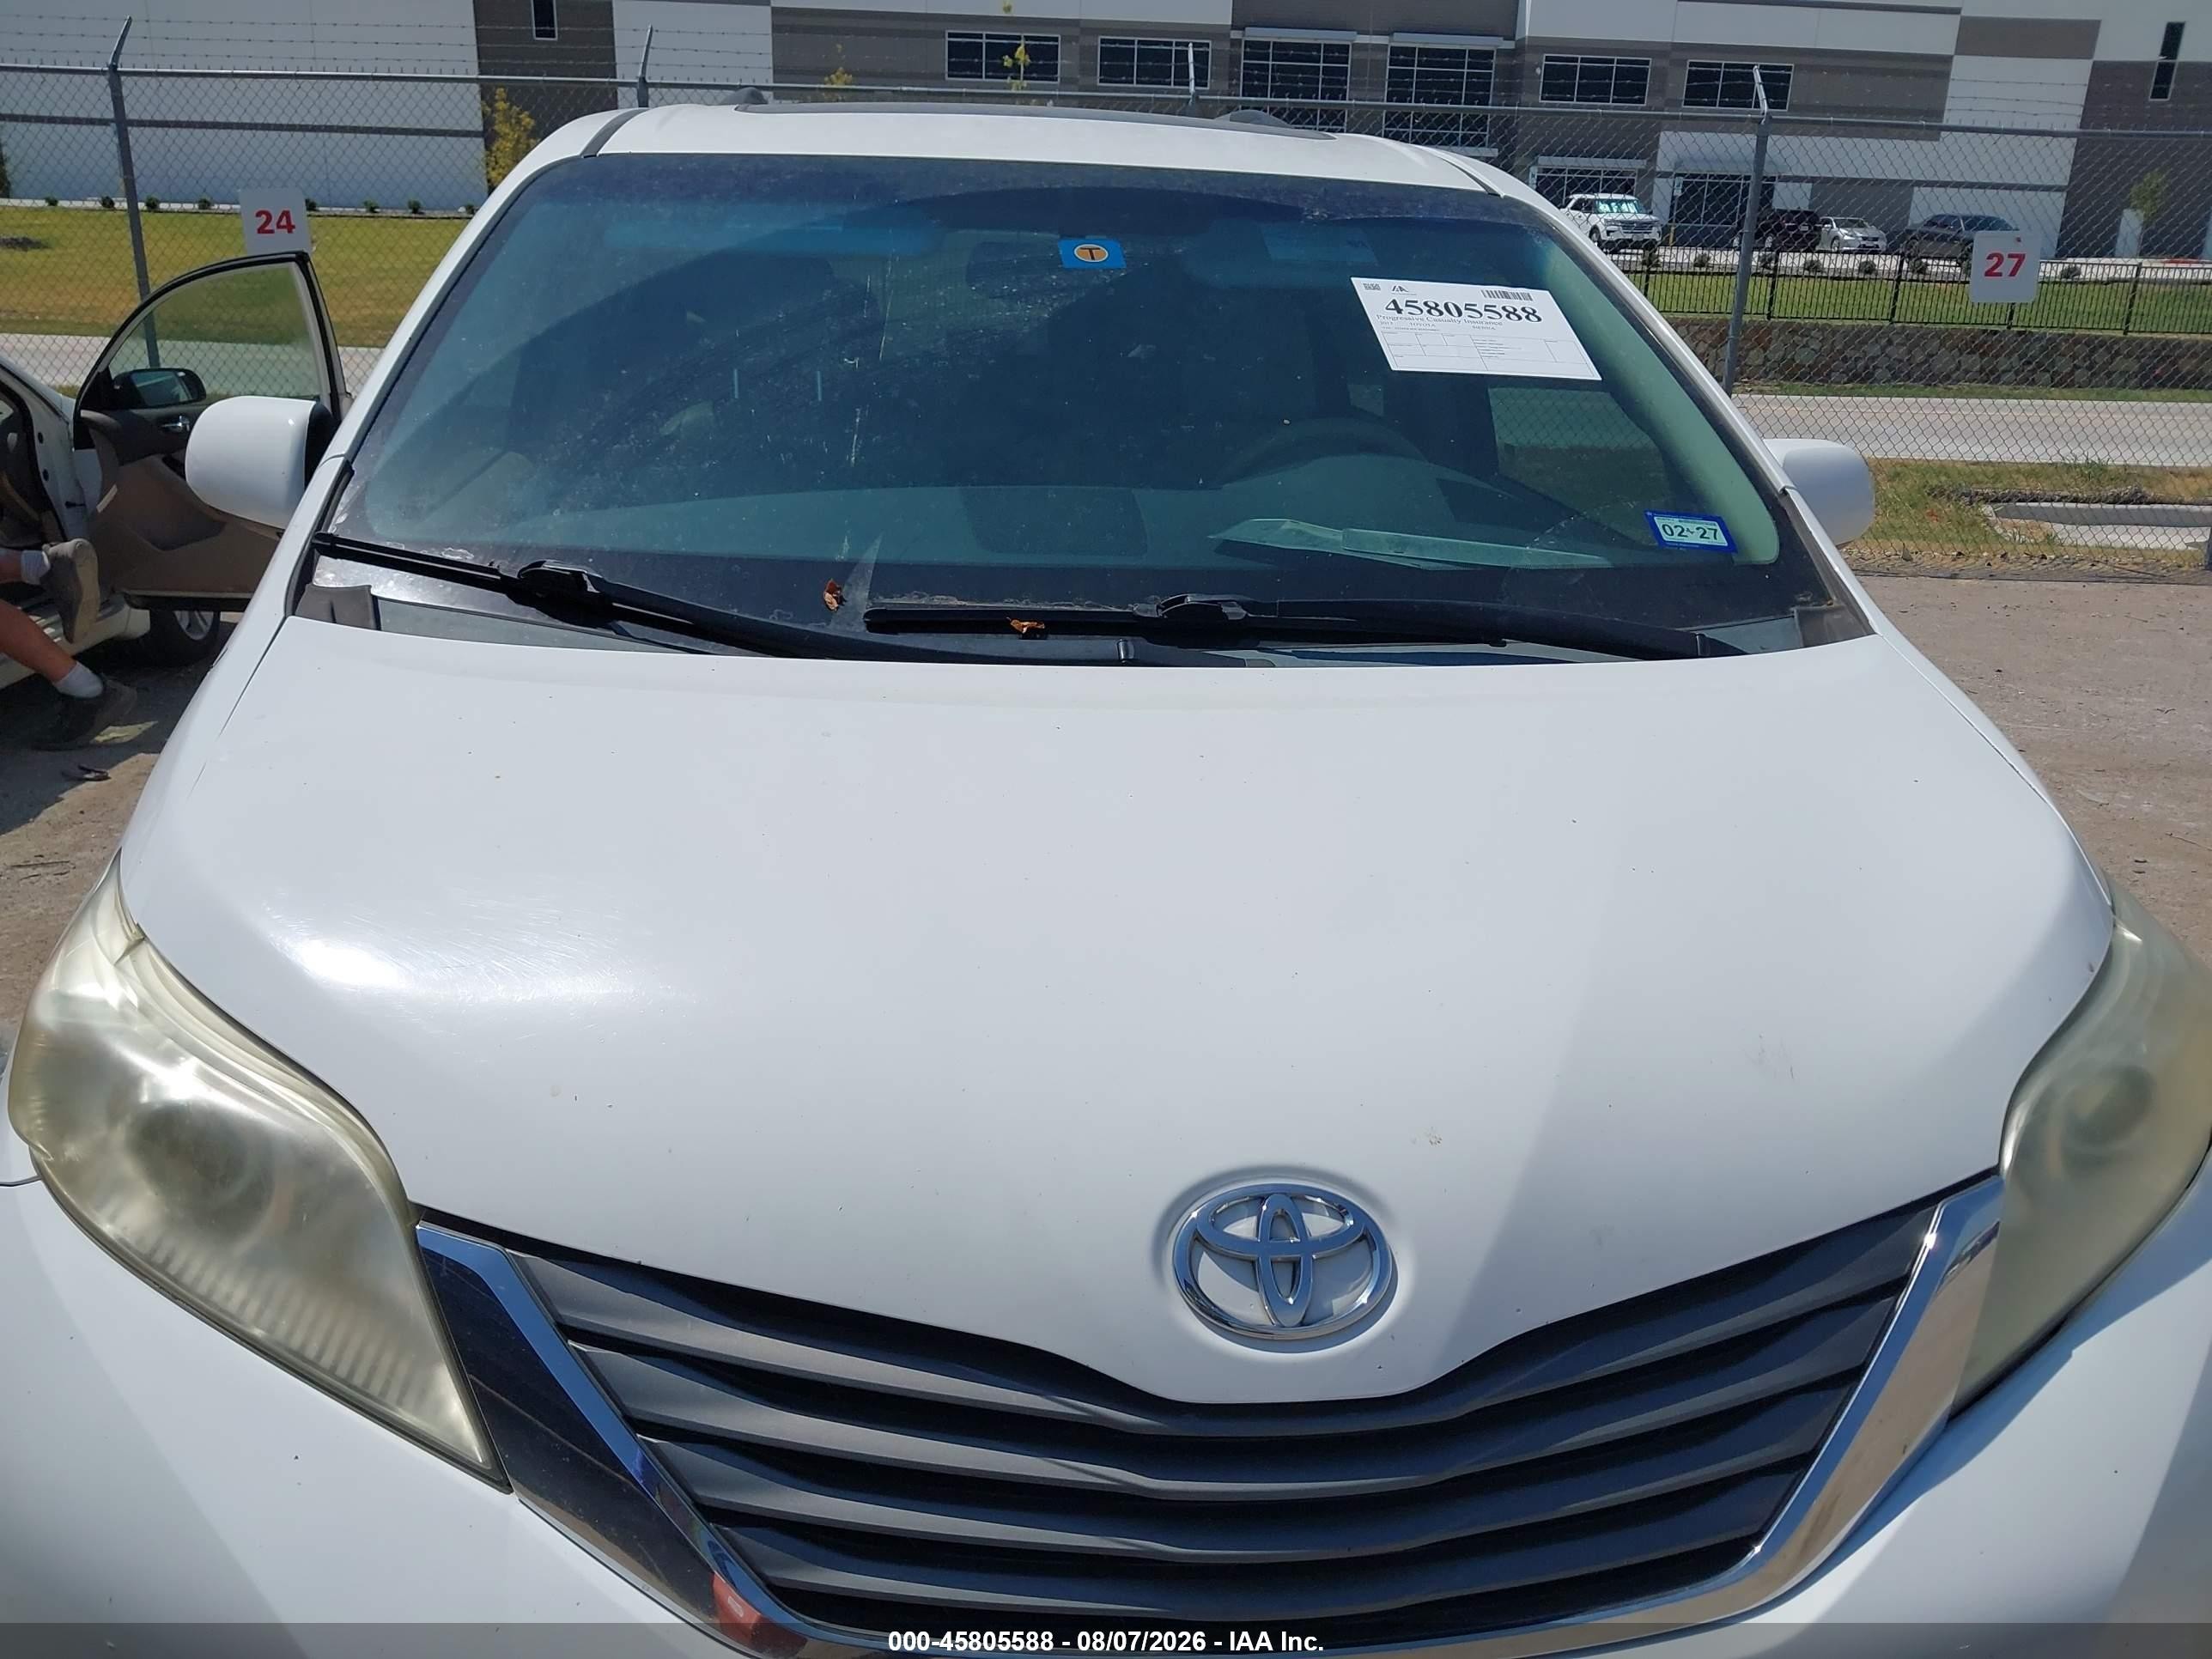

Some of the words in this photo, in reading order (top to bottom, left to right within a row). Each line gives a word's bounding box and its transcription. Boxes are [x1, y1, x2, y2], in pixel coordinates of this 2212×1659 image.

[255, 210, 296, 234] 24
[1079, 247, 1101, 261] T
[1984, 252, 2027, 277] 27
[1376, 313, 1423, 322] Progressive
[1425, 316, 1462, 325] Casualty
[1384, 298, 1543, 323] 45805588
